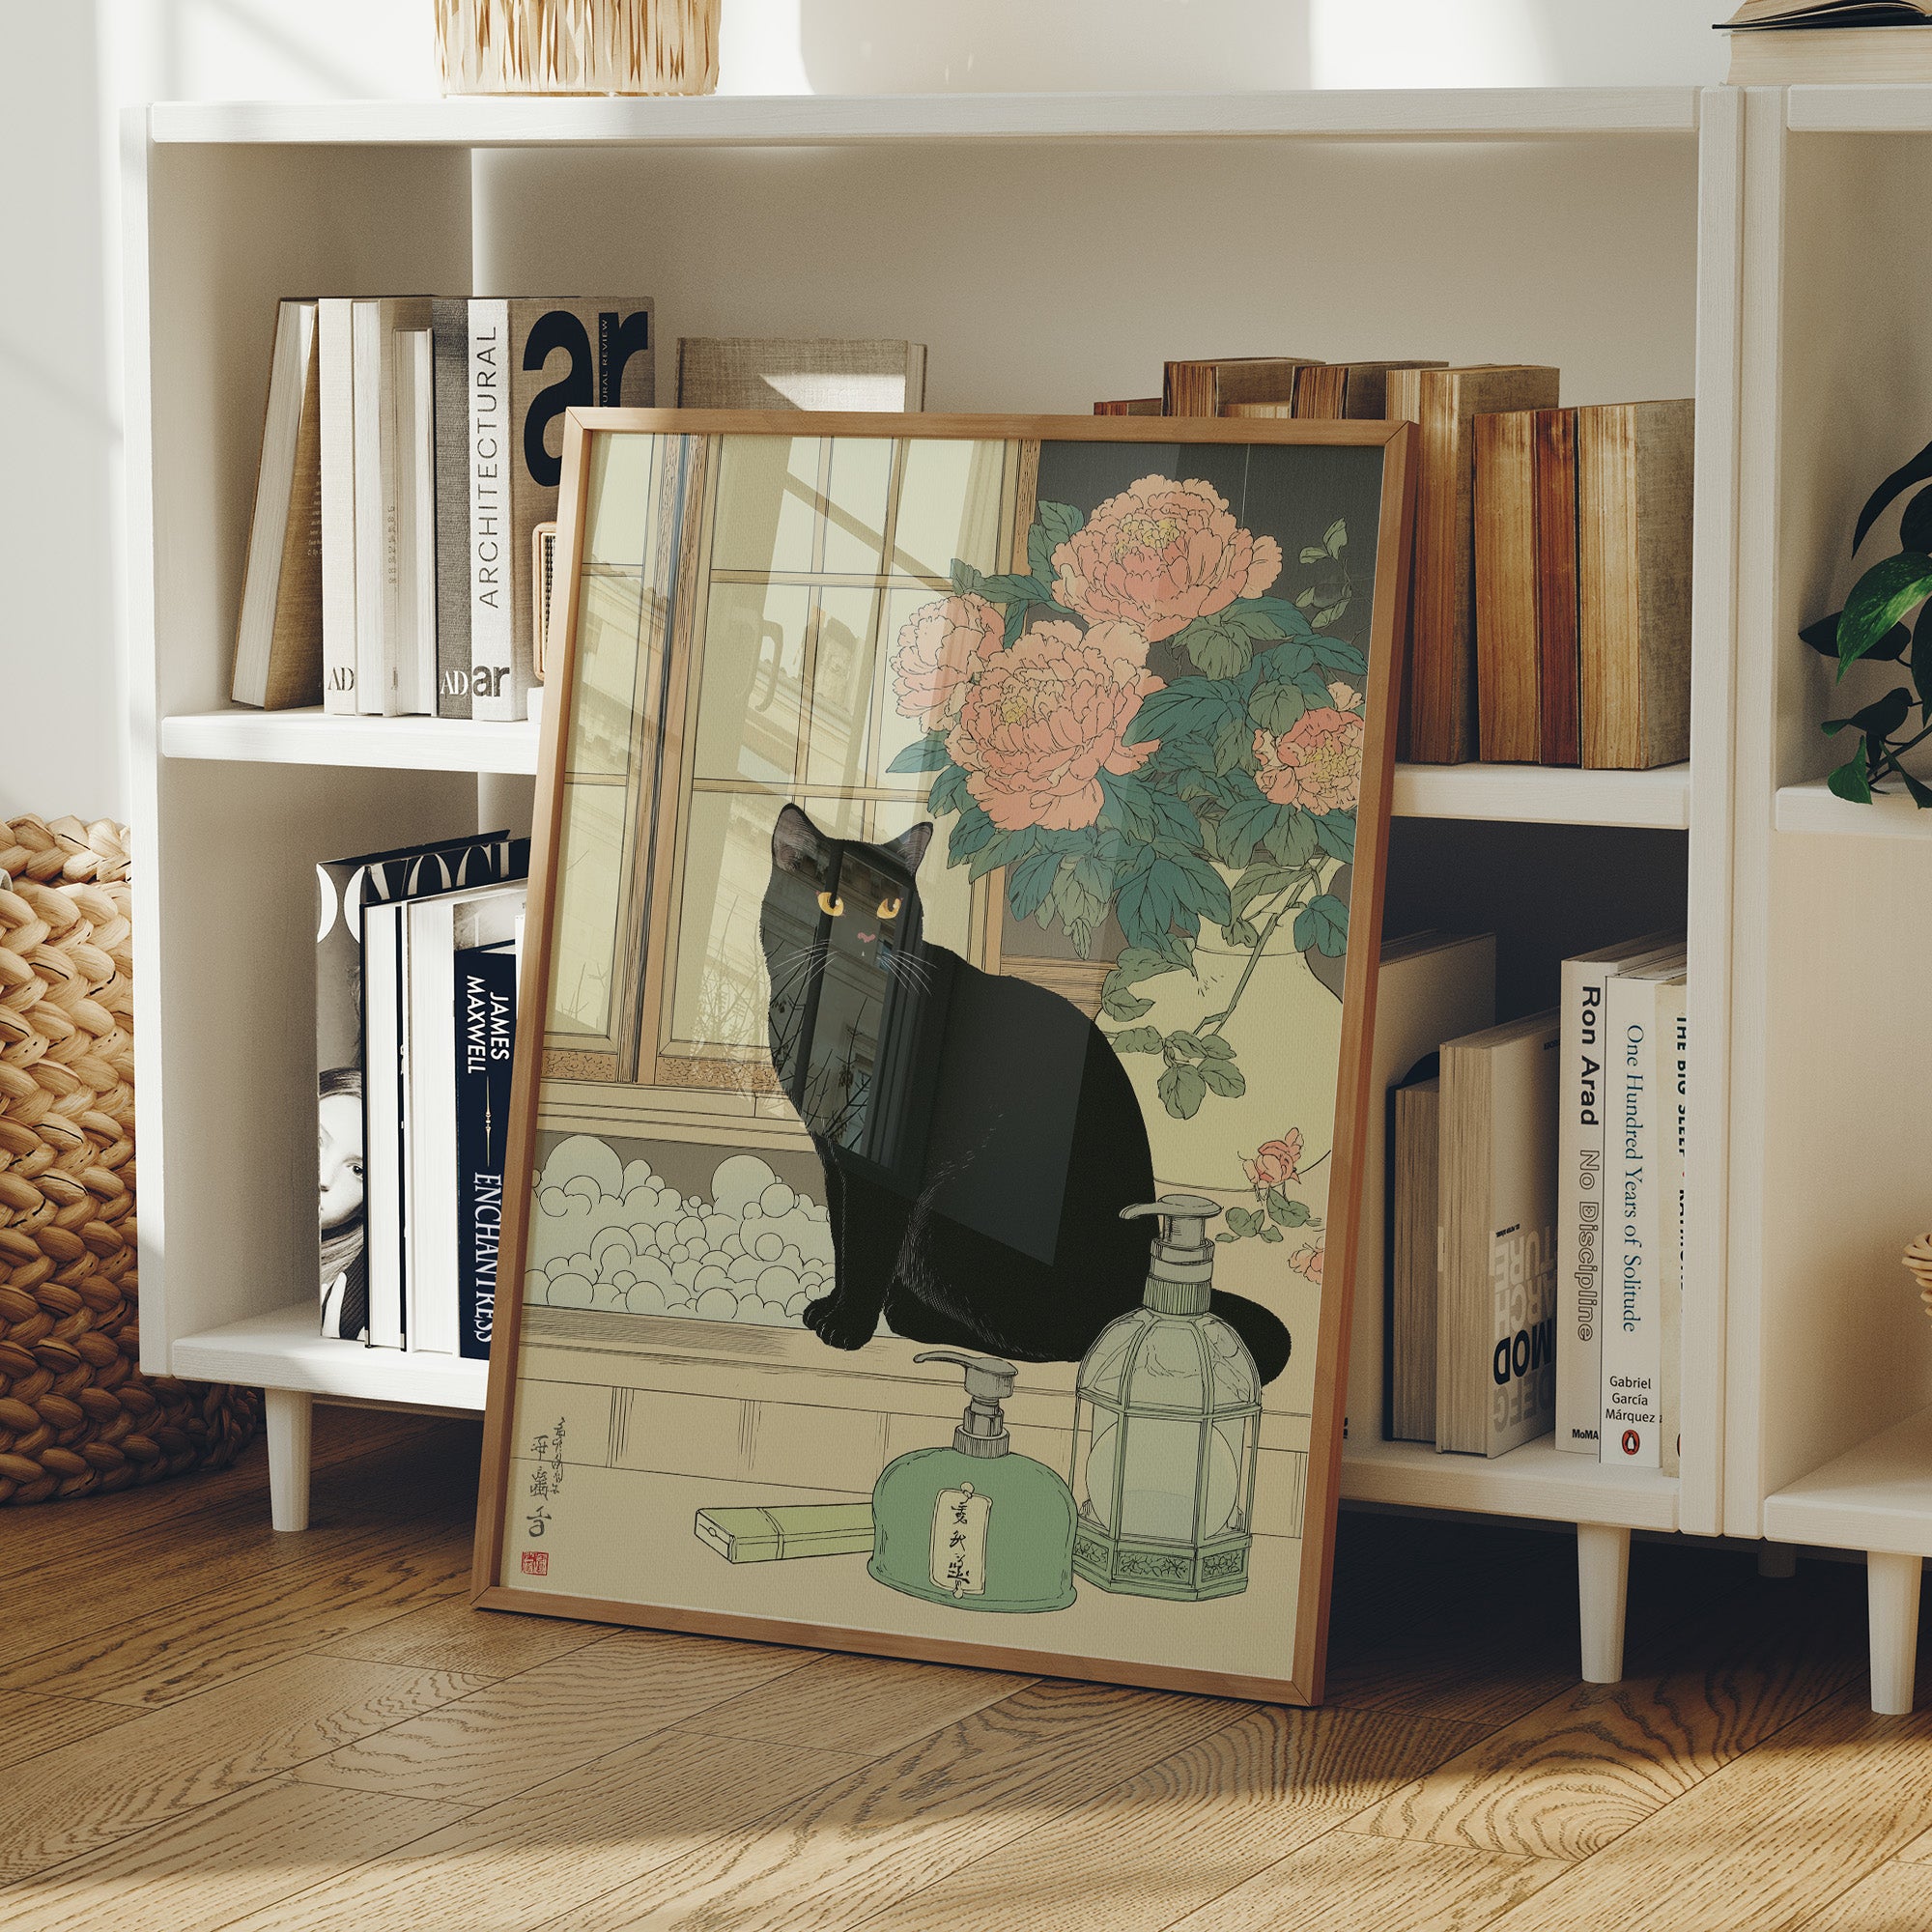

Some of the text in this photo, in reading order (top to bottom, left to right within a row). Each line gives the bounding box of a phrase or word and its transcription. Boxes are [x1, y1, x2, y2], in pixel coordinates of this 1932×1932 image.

[476, 327, 498, 609] ARCHITECTURAL
[327, 667, 355, 691] AD
[440, 669, 469, 696] AD
[472, 666, 510, 697] ar
[467, 975, 486, 1074] MAXWELL
[490, 991, 510, 1060] JAMES
[1575, 986, 1601, 1342] Ron Arad No Discipline
[1623, 1025, 1644, 1332] One Hundred Years of Solitude
[1493, 1319, 1552, 1385] MOD
[1609, 1376, 1651, 1389] Gabriel
[1611, 1392, 1648, 1406] García
[1605, 1408, 1655, 1423] Márquez
[1572, 1429, 1599, 1439] MoMA
